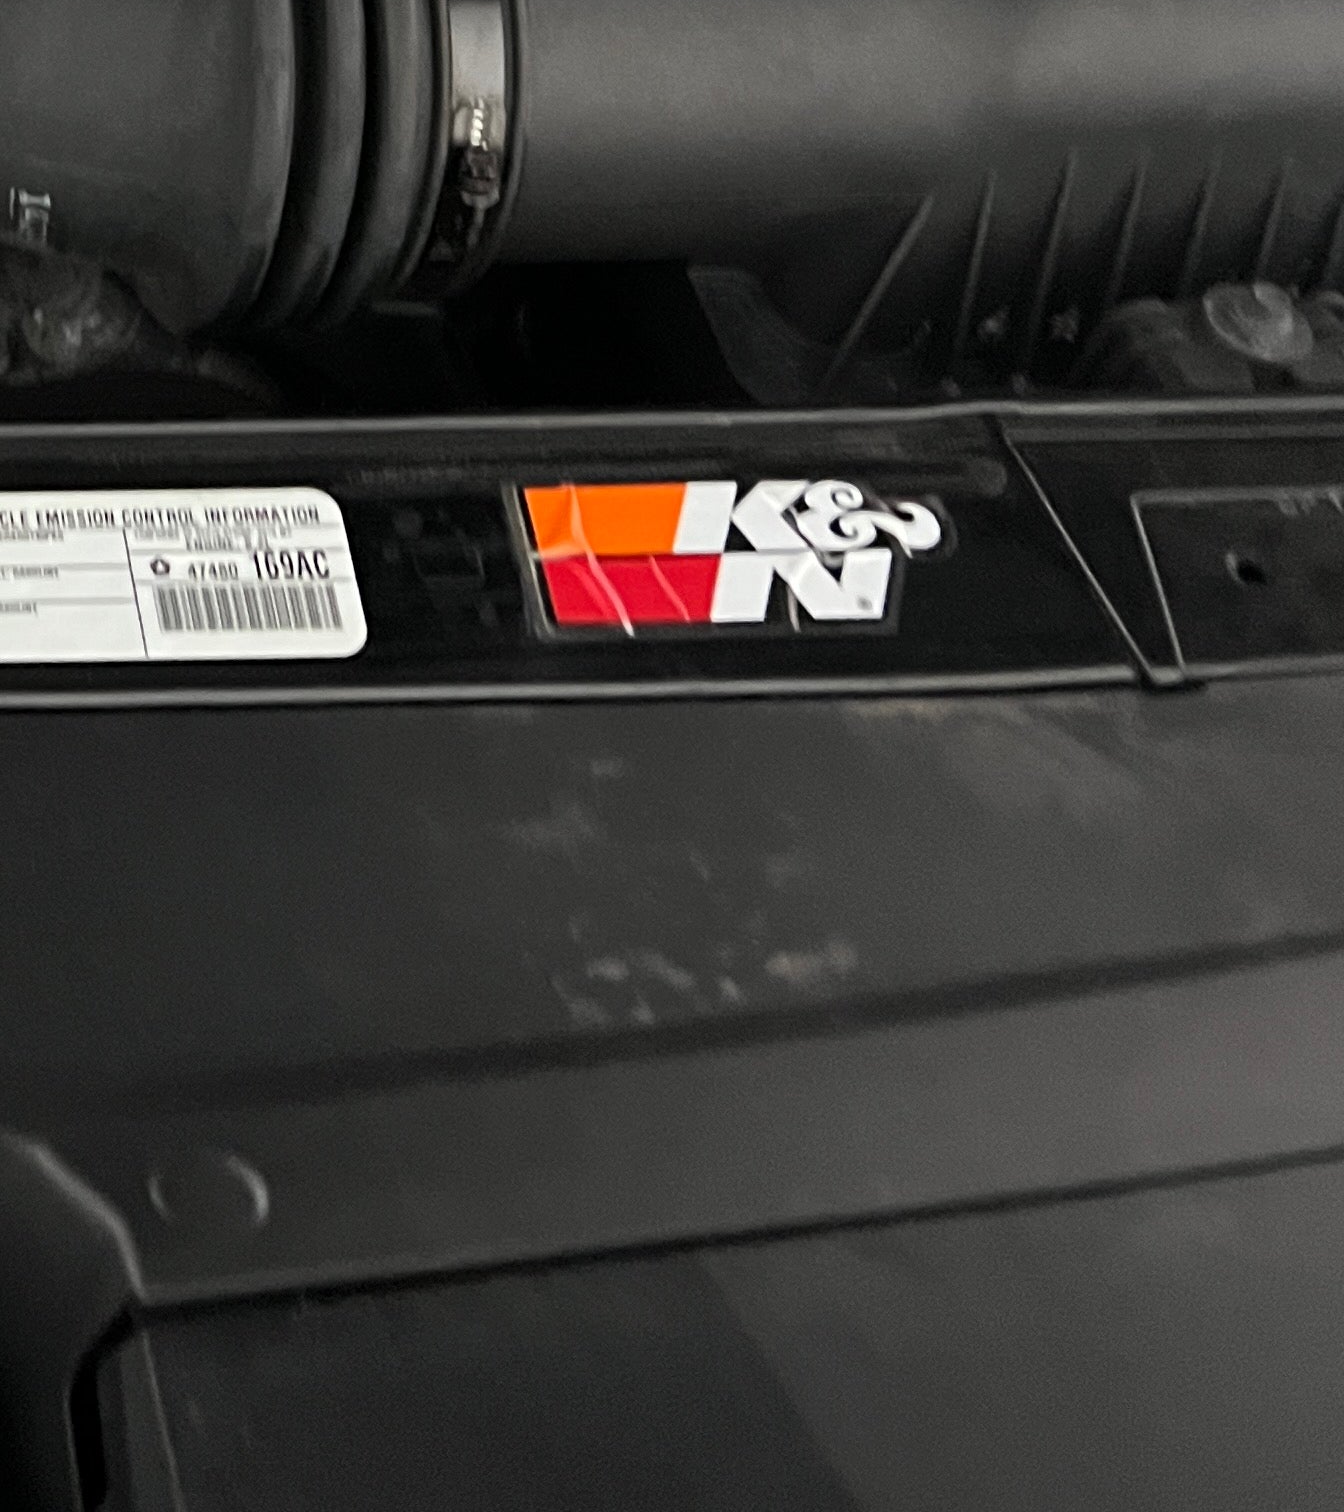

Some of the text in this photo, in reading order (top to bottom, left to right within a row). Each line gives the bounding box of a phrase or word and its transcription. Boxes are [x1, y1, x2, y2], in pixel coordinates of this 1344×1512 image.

[35, 508, 115, 528] EMISSION
[121, 506, 193, 527] CONTROL
[204, 504, 320, 525] INFORMATION
[673, 479, 941, 621] K&N
